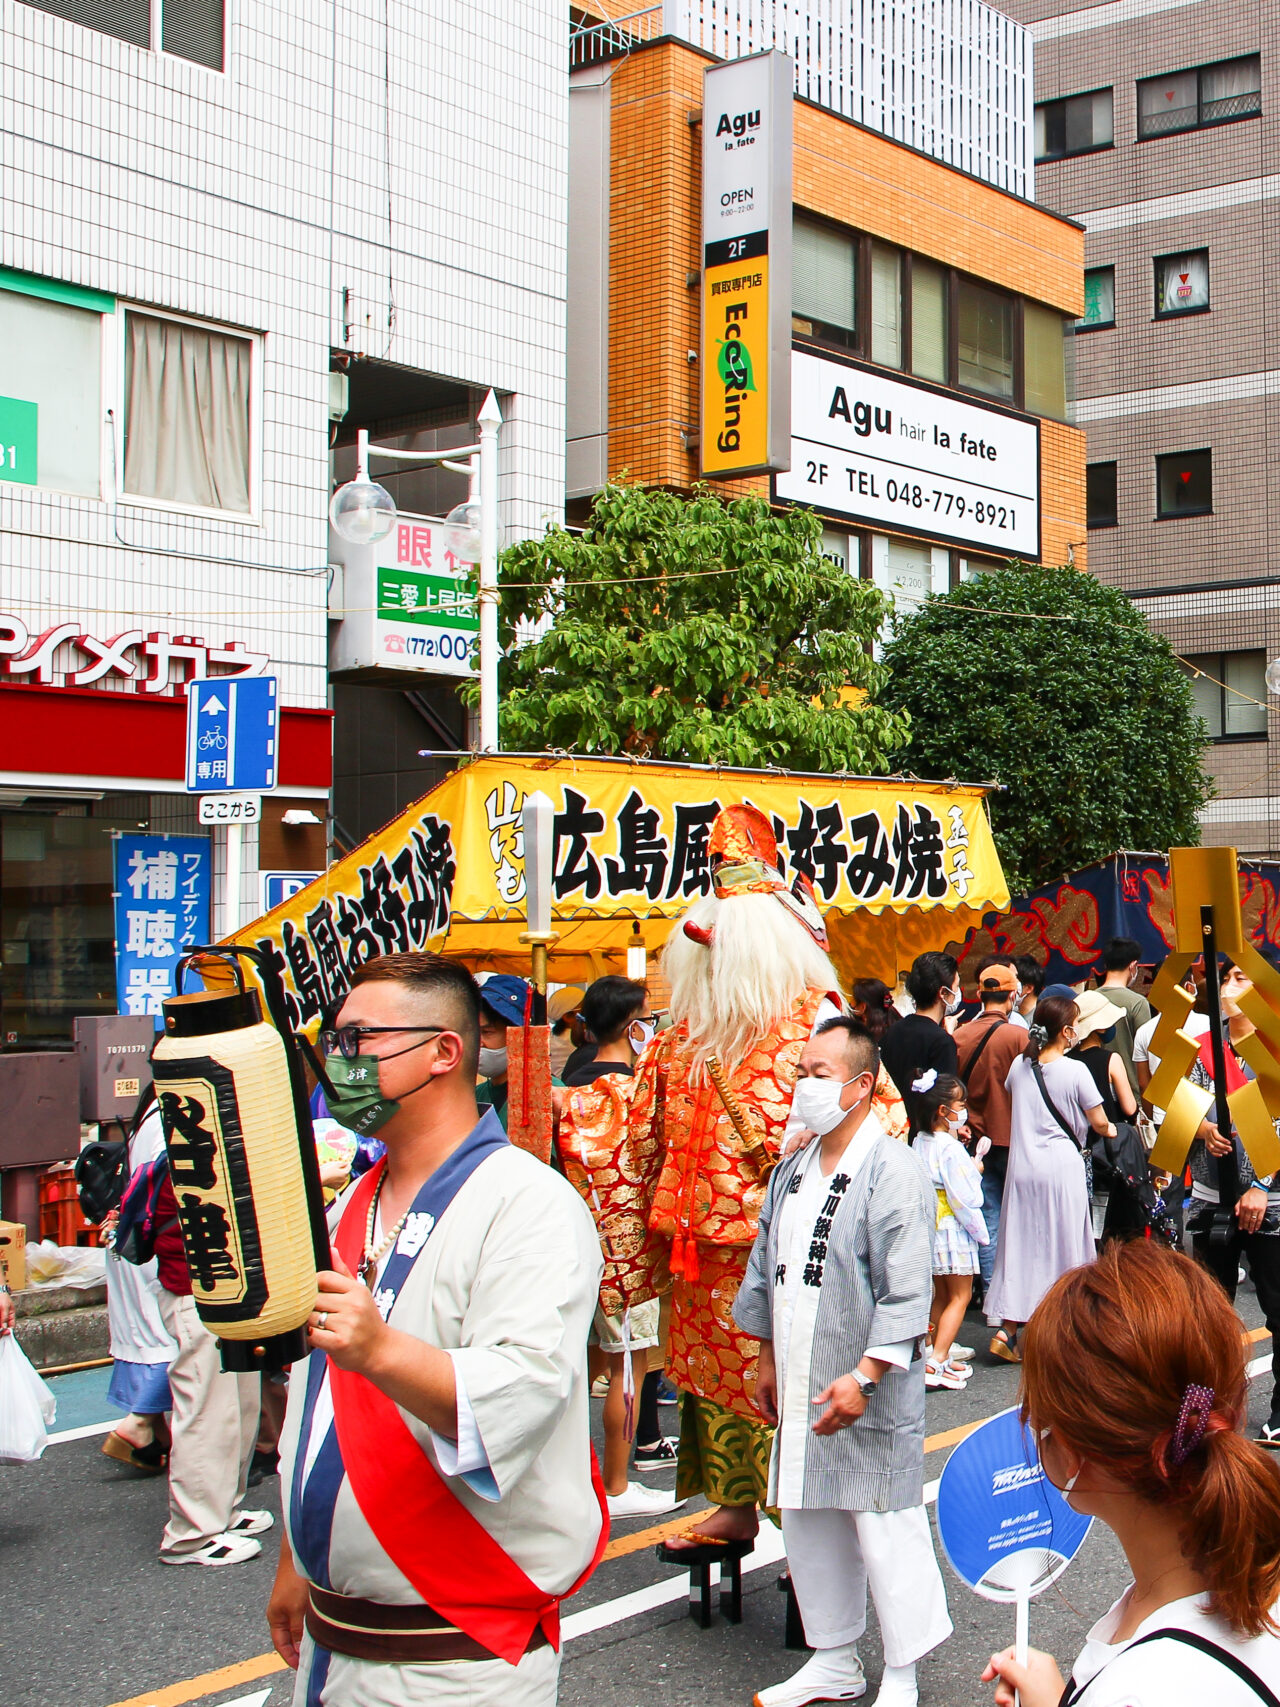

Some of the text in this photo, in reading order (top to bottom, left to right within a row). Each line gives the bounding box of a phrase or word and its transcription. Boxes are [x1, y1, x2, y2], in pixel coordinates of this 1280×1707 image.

[716, 109, 761, 137] Agu
[720, 187, 754, 207] OPEN
[728, 239, 748, 260] 2F
[711, 272, 763, 297] 買取専門店
[715, 302, 748, 454] EcoRing
[828, 386, 997, 462] Agu hair la_fate
[806, 460, 1016, 532] 2F TEL 048-779-8921
[381, 581, 478, 621] 三愛上尾医
[197, 760, 227, 779] 専用
[203, 802, 257, 818] ここから
[553, 786, 950, 903] 広島風好み焼
[945, 803, 976, 899] 玉子
[124, 850, 179, 1017] 補聴器
[179, 853, 202, 958] ワイデック
